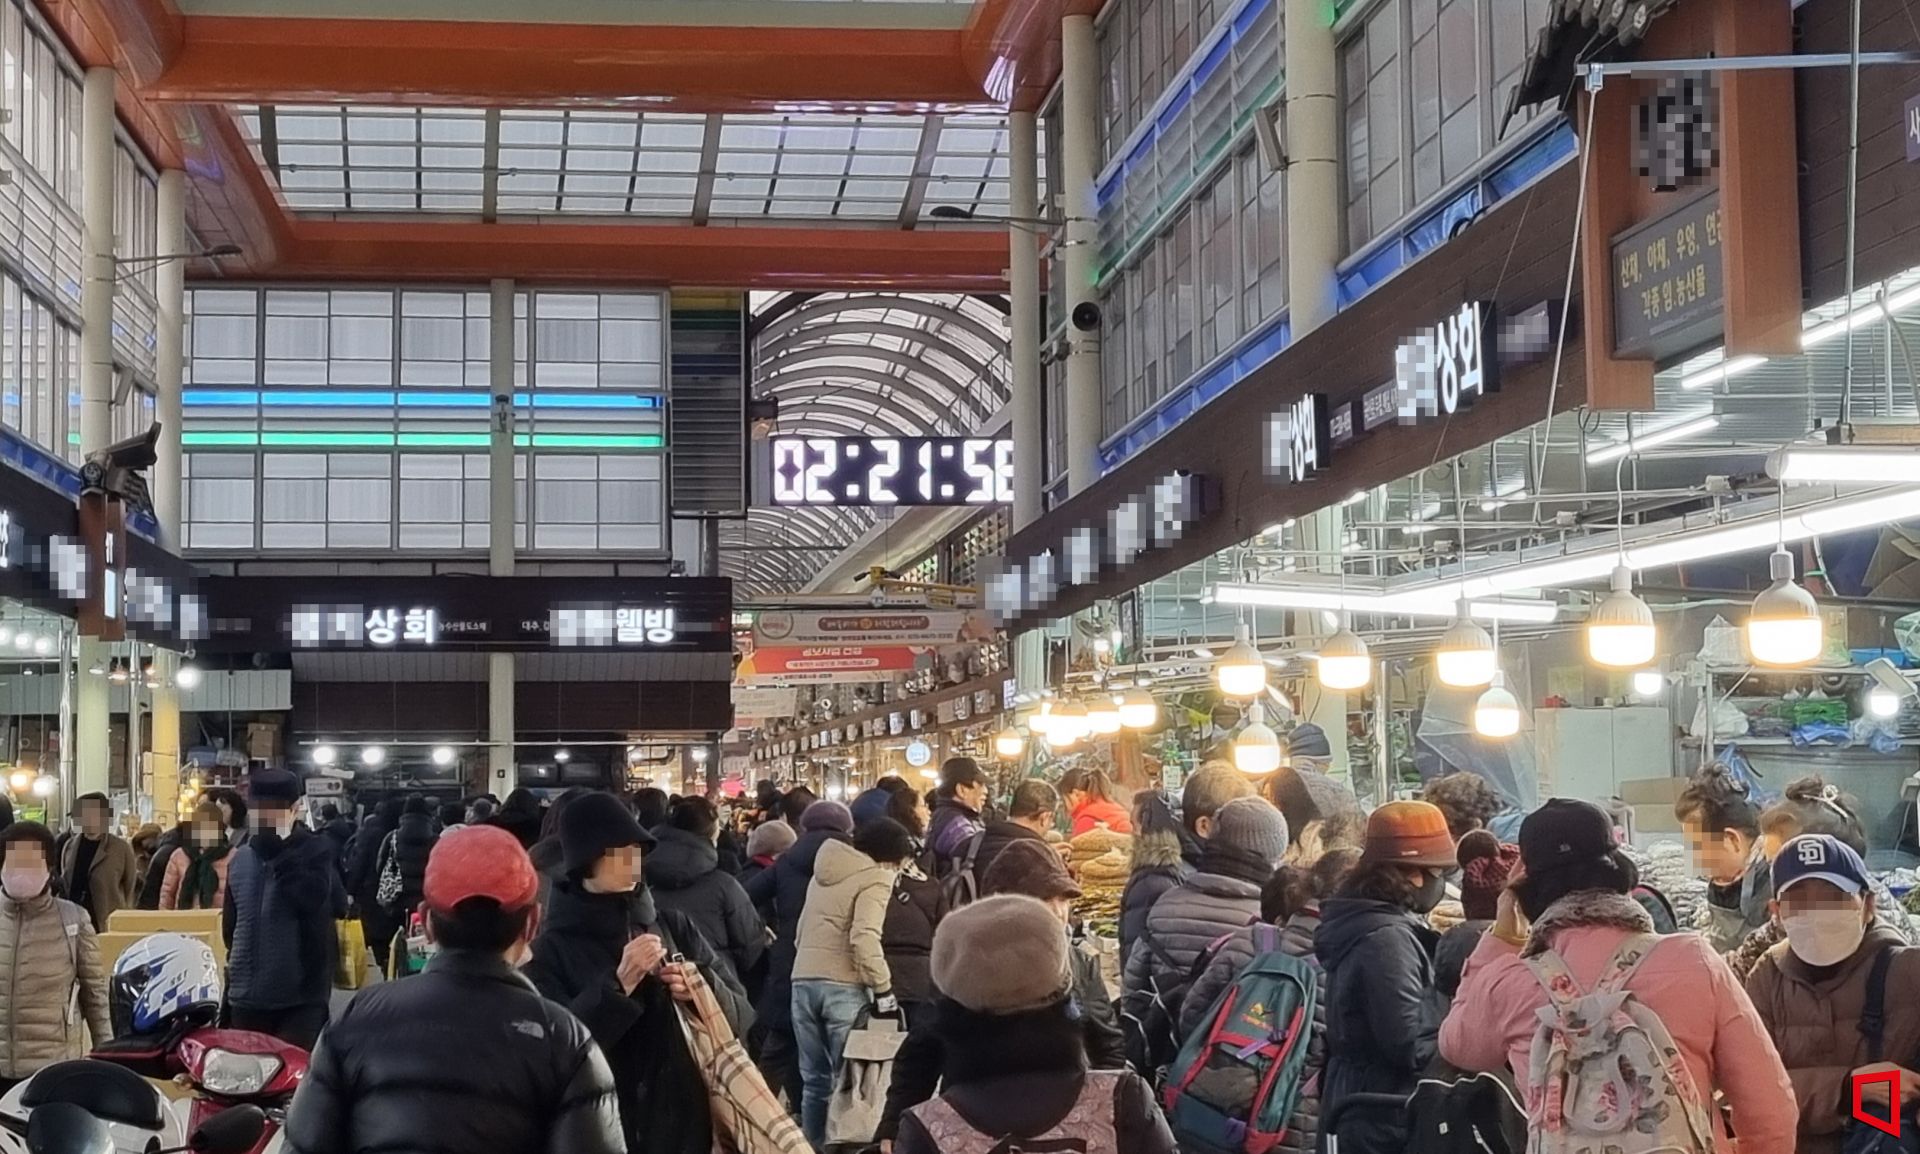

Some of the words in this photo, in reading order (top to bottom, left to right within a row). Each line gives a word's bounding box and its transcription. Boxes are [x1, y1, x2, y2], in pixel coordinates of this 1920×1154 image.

[1676, 222, 1700, 259] 우엉,
[1437, 301, 1484, 414] 상회
[1291, 393, 1317, 482] 상회
[365, 608, 435, 644] 상회
[616, 608, 675, 643] 웰빙
[1798, 839, 1826, 865] SD
